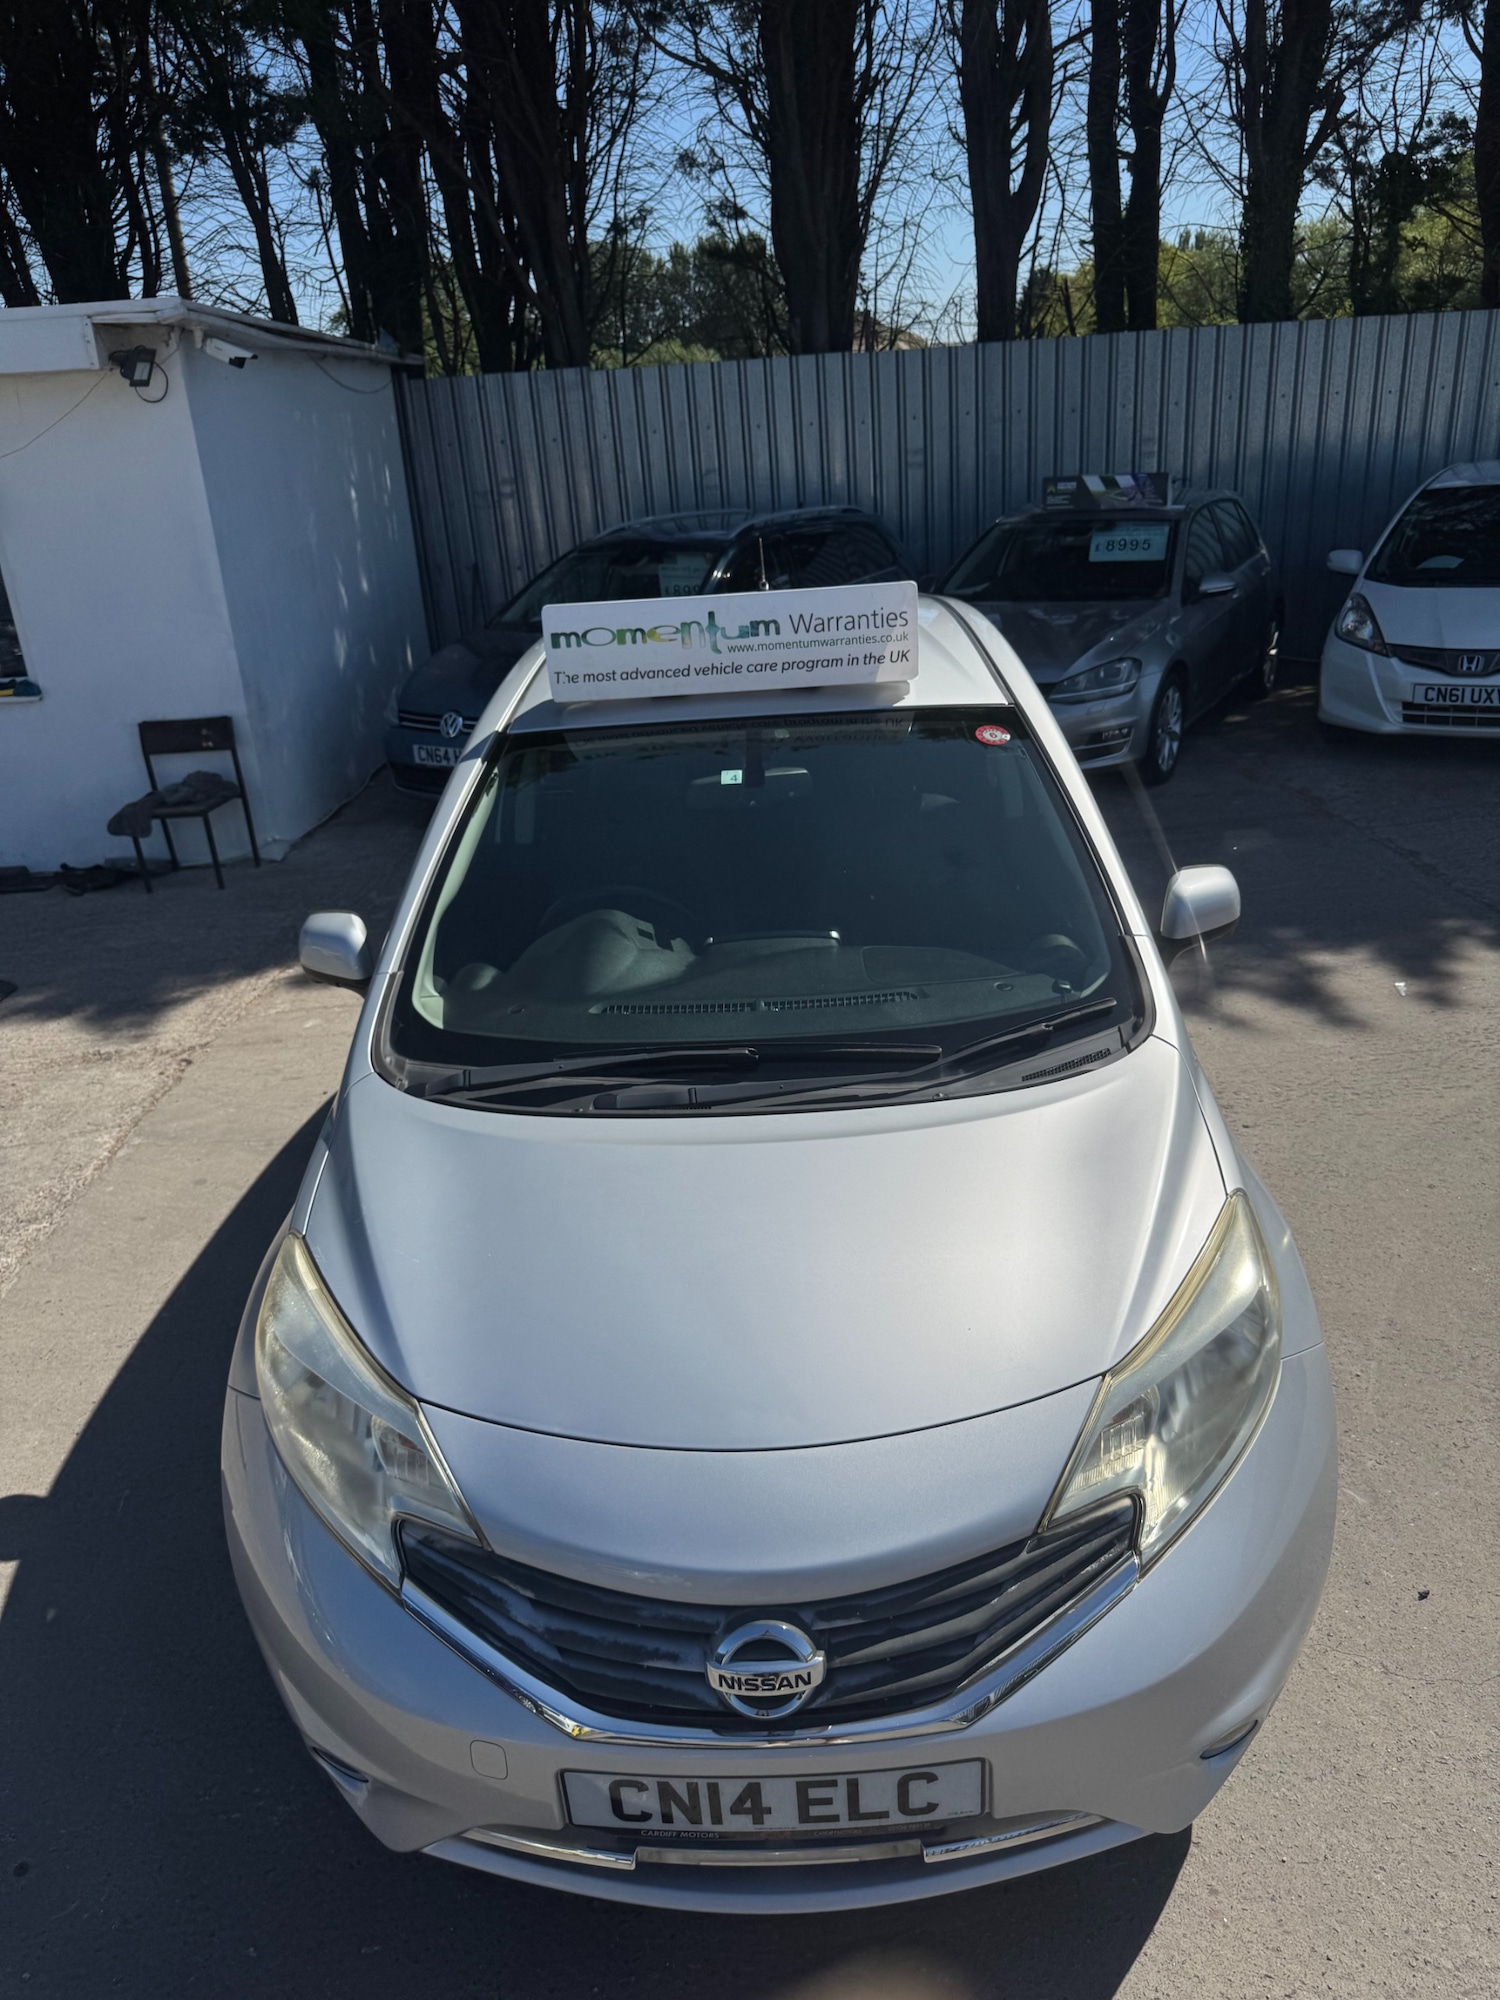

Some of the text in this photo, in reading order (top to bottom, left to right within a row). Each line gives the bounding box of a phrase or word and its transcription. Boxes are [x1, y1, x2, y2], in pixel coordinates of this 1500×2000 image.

[551, 607, 909, 654] momentum Warranties
[727, 631, 909, 654] www.momentumwarranties.co.uk
[554, 650, 910, 685] The most advanced vehicle care program in the UK
[1424, 686, 1500, 705] CN61 UX
[418, 746, 451, 764] CN64
[718, 1671, 812, 1692] NISSAN
[609, 1771, 939, 1825] CN14 ELC
[640, 1829, 720, 1839] CARDIFF MOTORS
